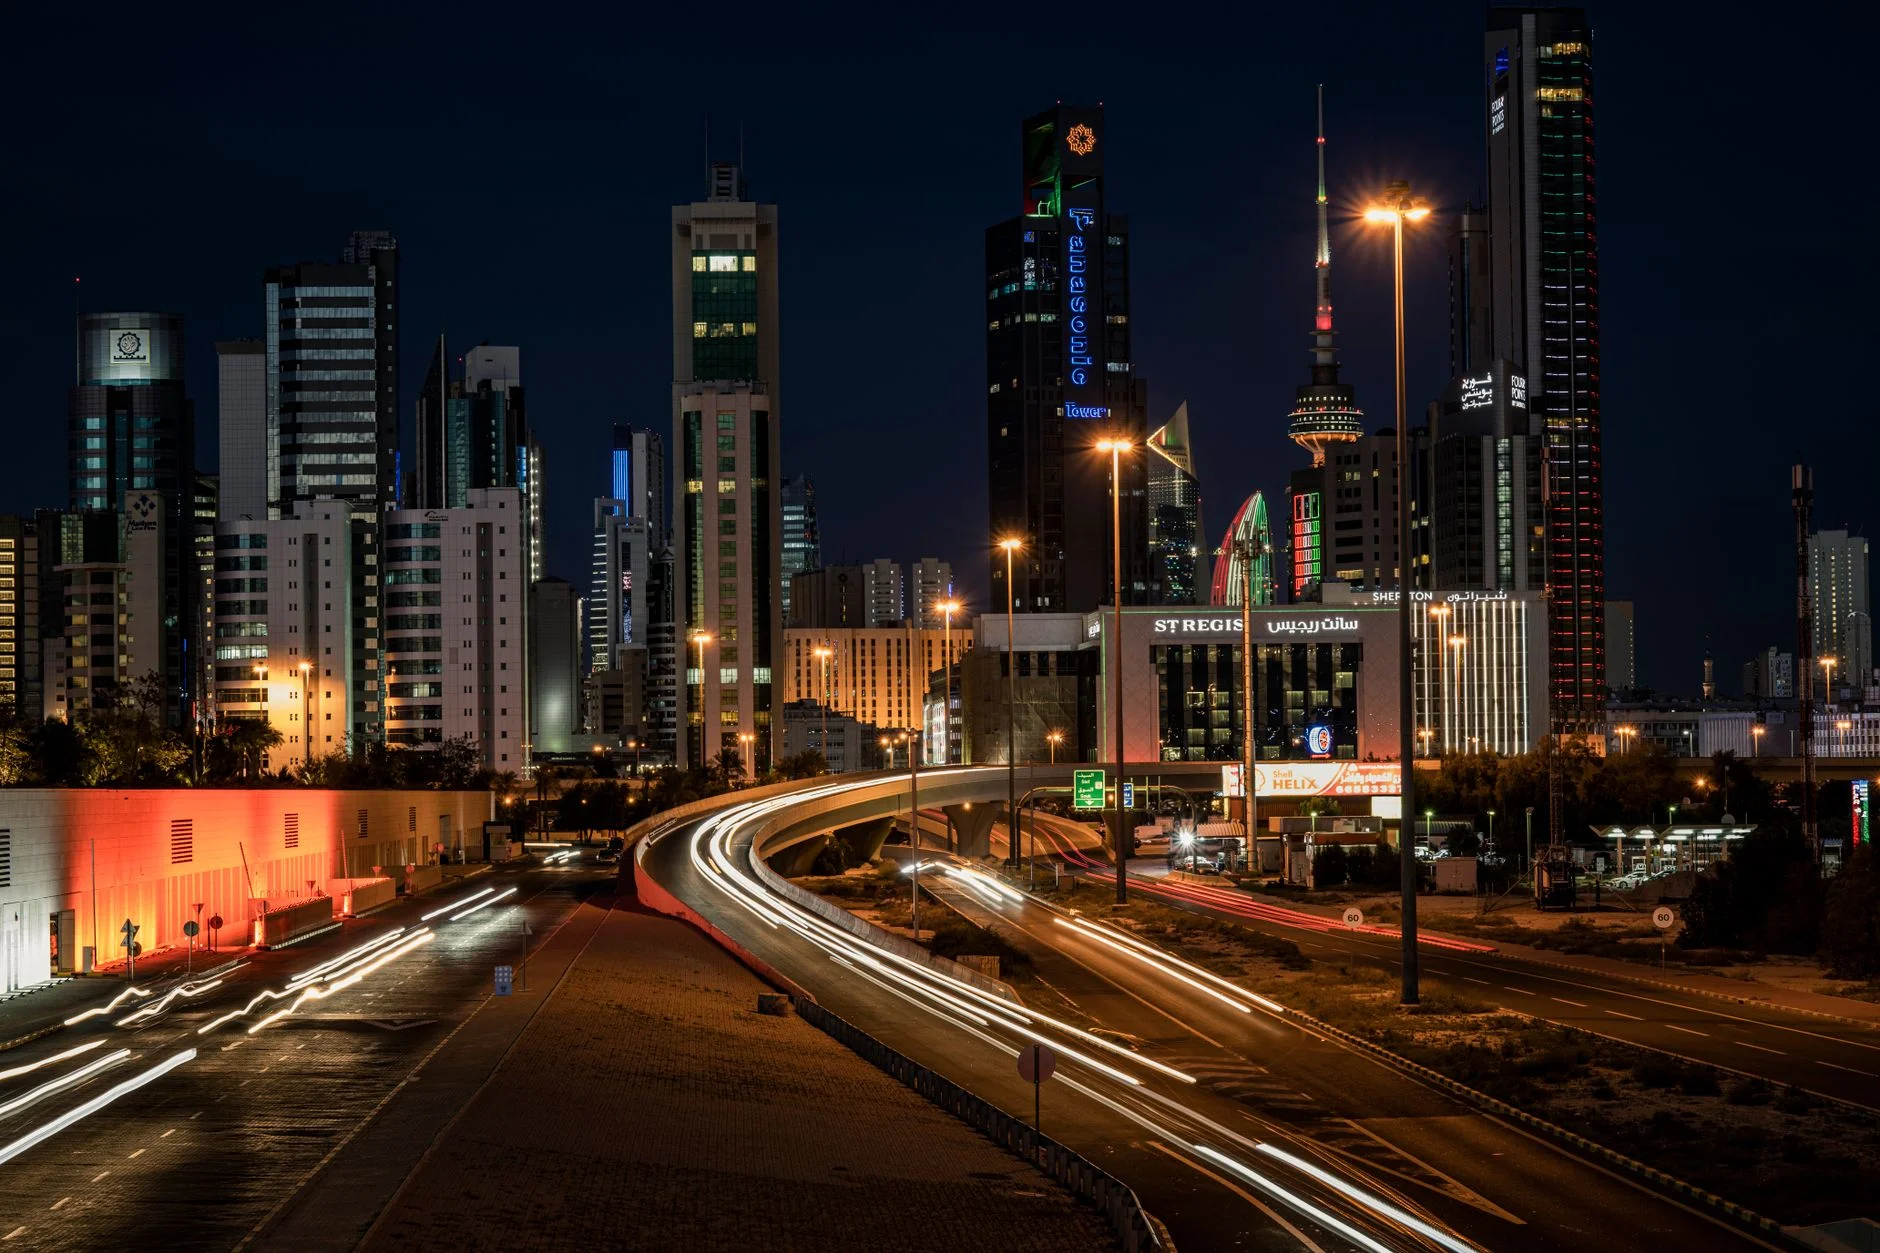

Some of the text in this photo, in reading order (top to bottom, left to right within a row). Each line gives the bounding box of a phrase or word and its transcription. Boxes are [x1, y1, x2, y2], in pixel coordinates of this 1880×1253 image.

[1069, 208, 1095, 385] Panasonic
[1064, 401, 1107, 418] Tower
[1372, 591, 1433, 602] SHERTON
[1447, 590, 1508, 602] شيراتون
[1182, 618, 1244, 632] REGIS
[1267, 617, 1359, 634] سانت ريجيس
[1273, 769, 1293, 777] Shell
[1272, 776, 1318, 789] HELIX
[1347, 914, 1359, 922] 60
[1657, 913, 1670, 922] 60
